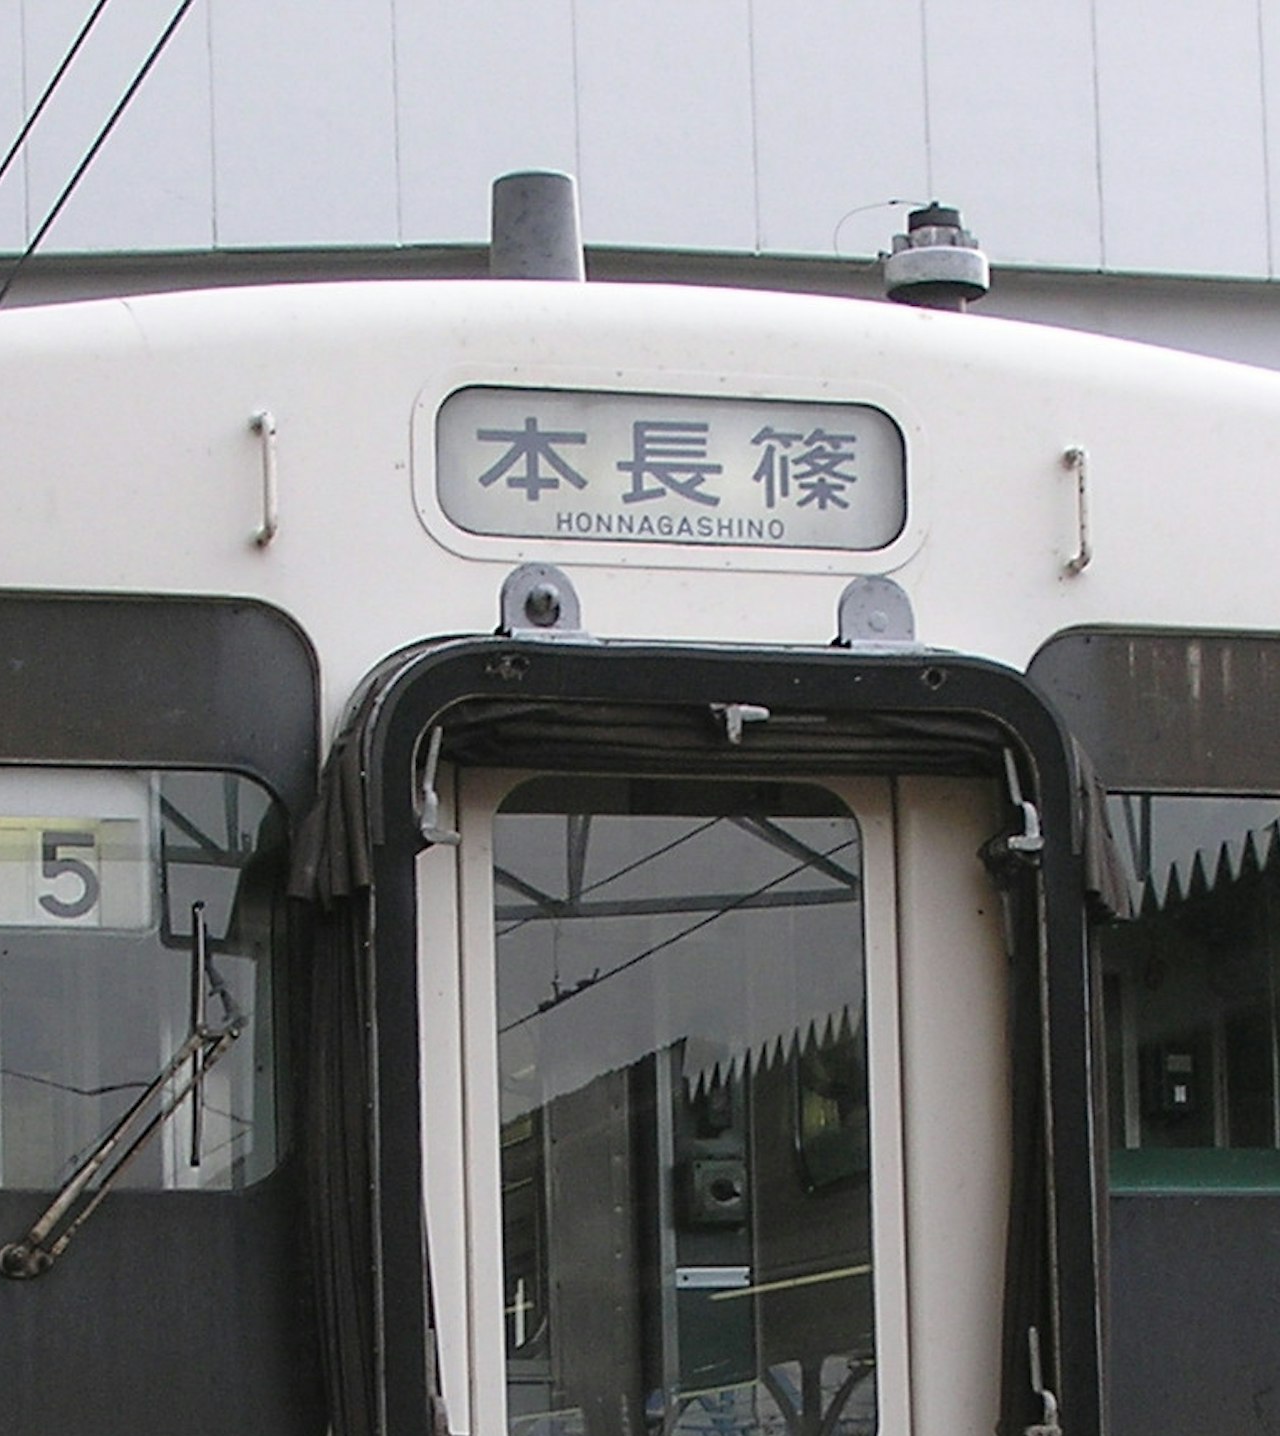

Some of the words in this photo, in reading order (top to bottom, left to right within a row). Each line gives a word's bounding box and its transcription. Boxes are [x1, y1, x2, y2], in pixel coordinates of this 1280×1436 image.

[476, 417, 857, 510] 本長篠
[556, 512, 785, 540] HONNAGASHINO
[38, 832, 100, 918] 5
